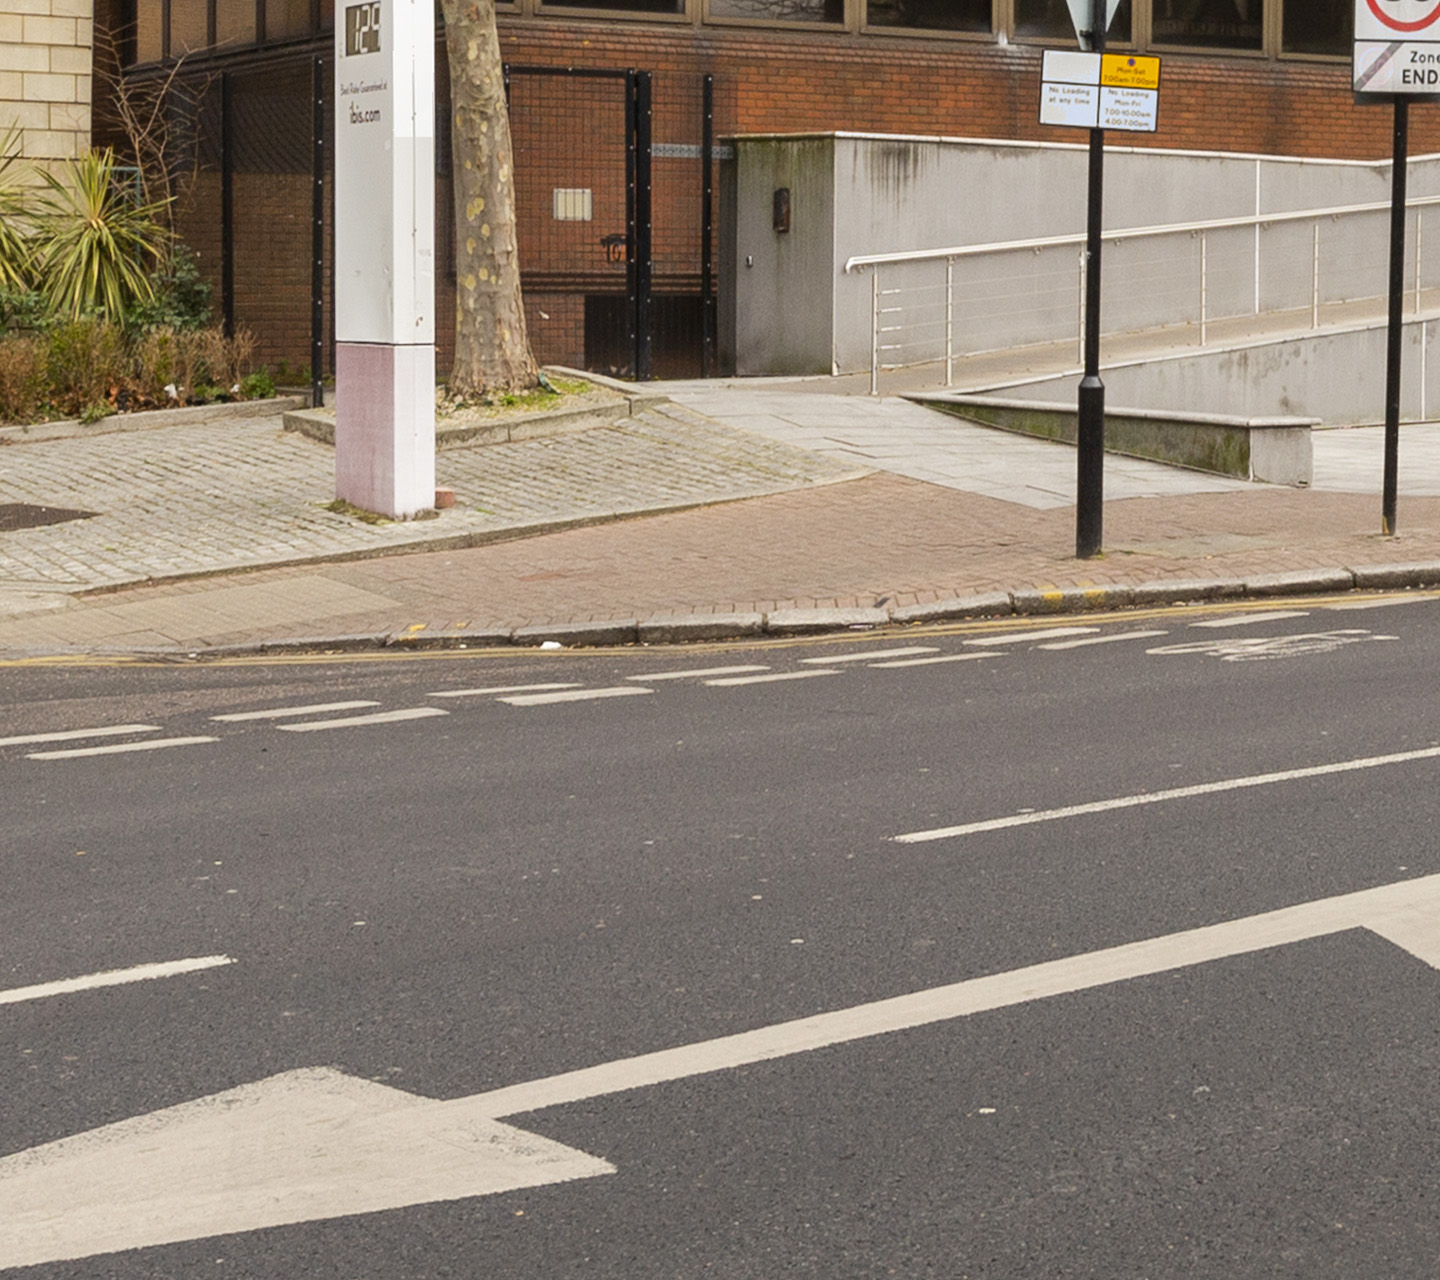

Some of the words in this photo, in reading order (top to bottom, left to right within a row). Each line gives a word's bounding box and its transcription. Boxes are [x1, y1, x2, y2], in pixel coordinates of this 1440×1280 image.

[355, 3, 380, 53] 129
[1048, 86, 1059, 94] No
[1062, 87, 1091, 96] Loading
[1121, 89, 1149, 99] Loading
[1059, 98, 1071, 107] any
[1074, 97, 1090, 105] time
[349, 101, 381, 124] ibis.com
